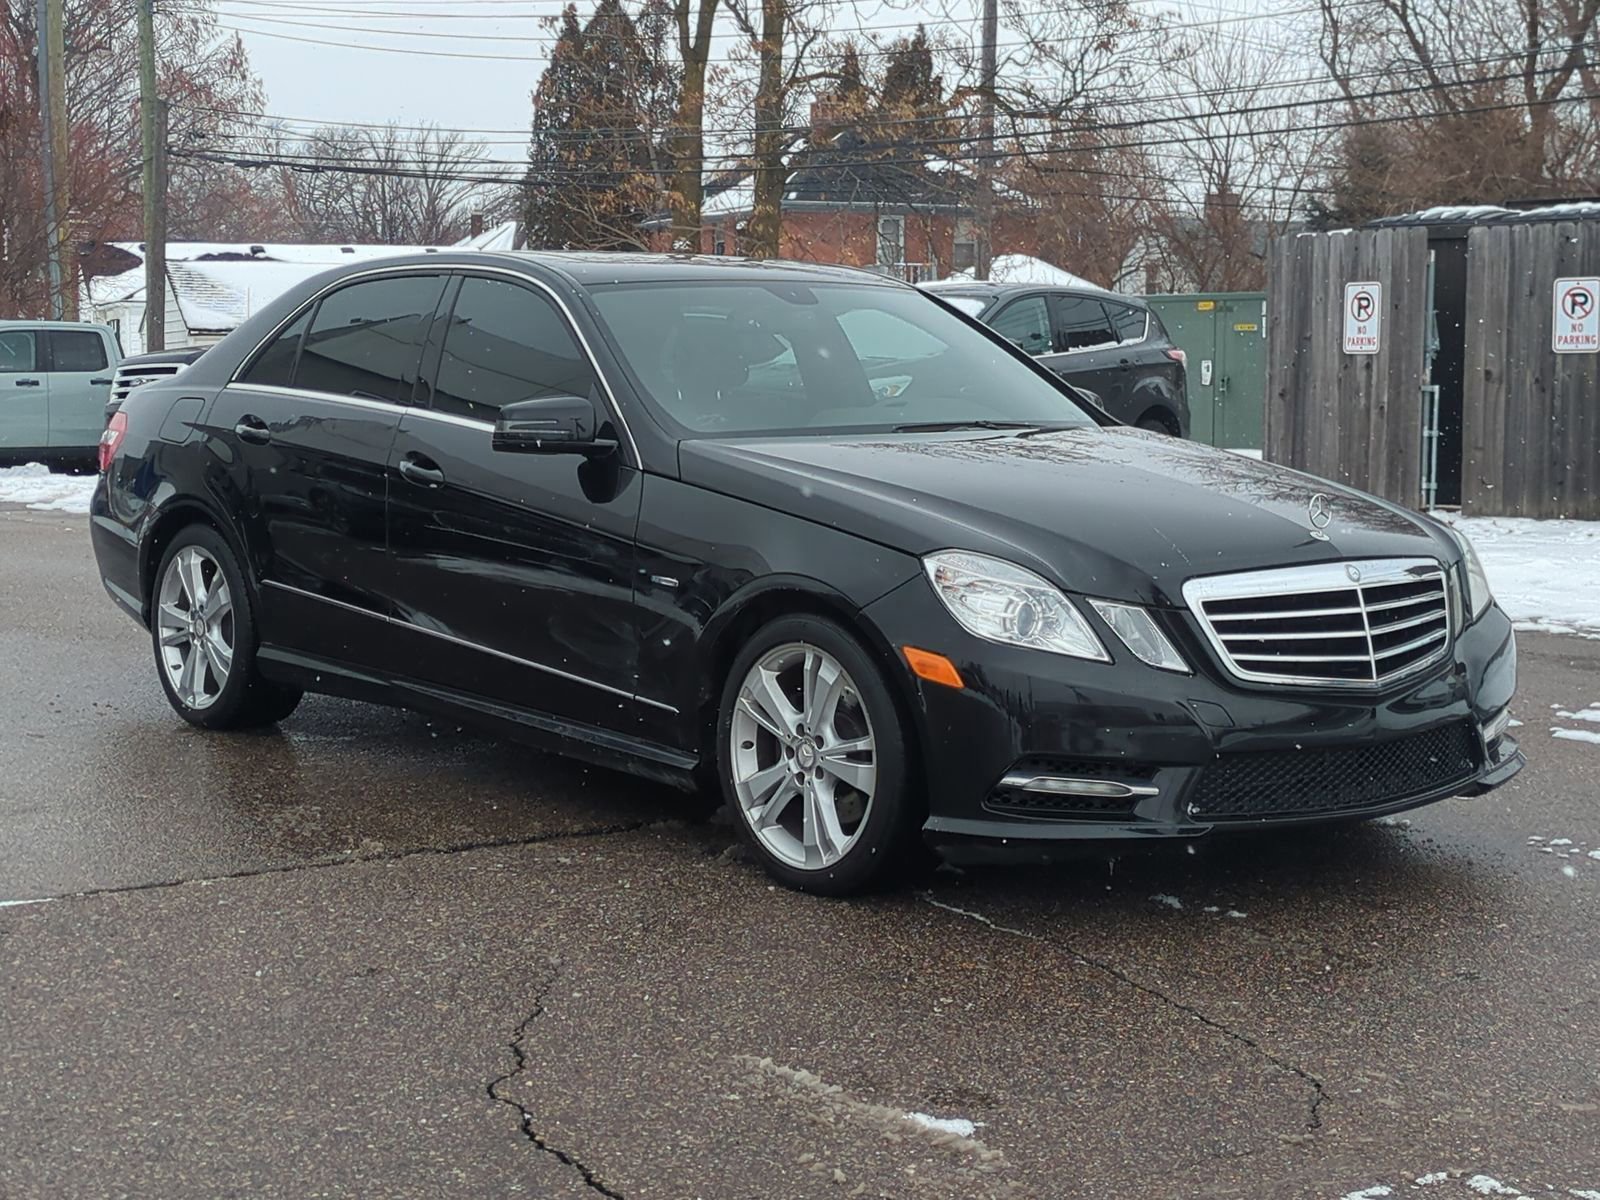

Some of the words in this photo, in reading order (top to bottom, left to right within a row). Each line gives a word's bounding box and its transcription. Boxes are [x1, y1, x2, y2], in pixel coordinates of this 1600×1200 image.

[1357, 326, 1367, 335] NO
[1571, 323, 1584, 333] NO
[1347, 336, 1377, 347] PARKING
[1557, 335, 1597, 345] PARKING
